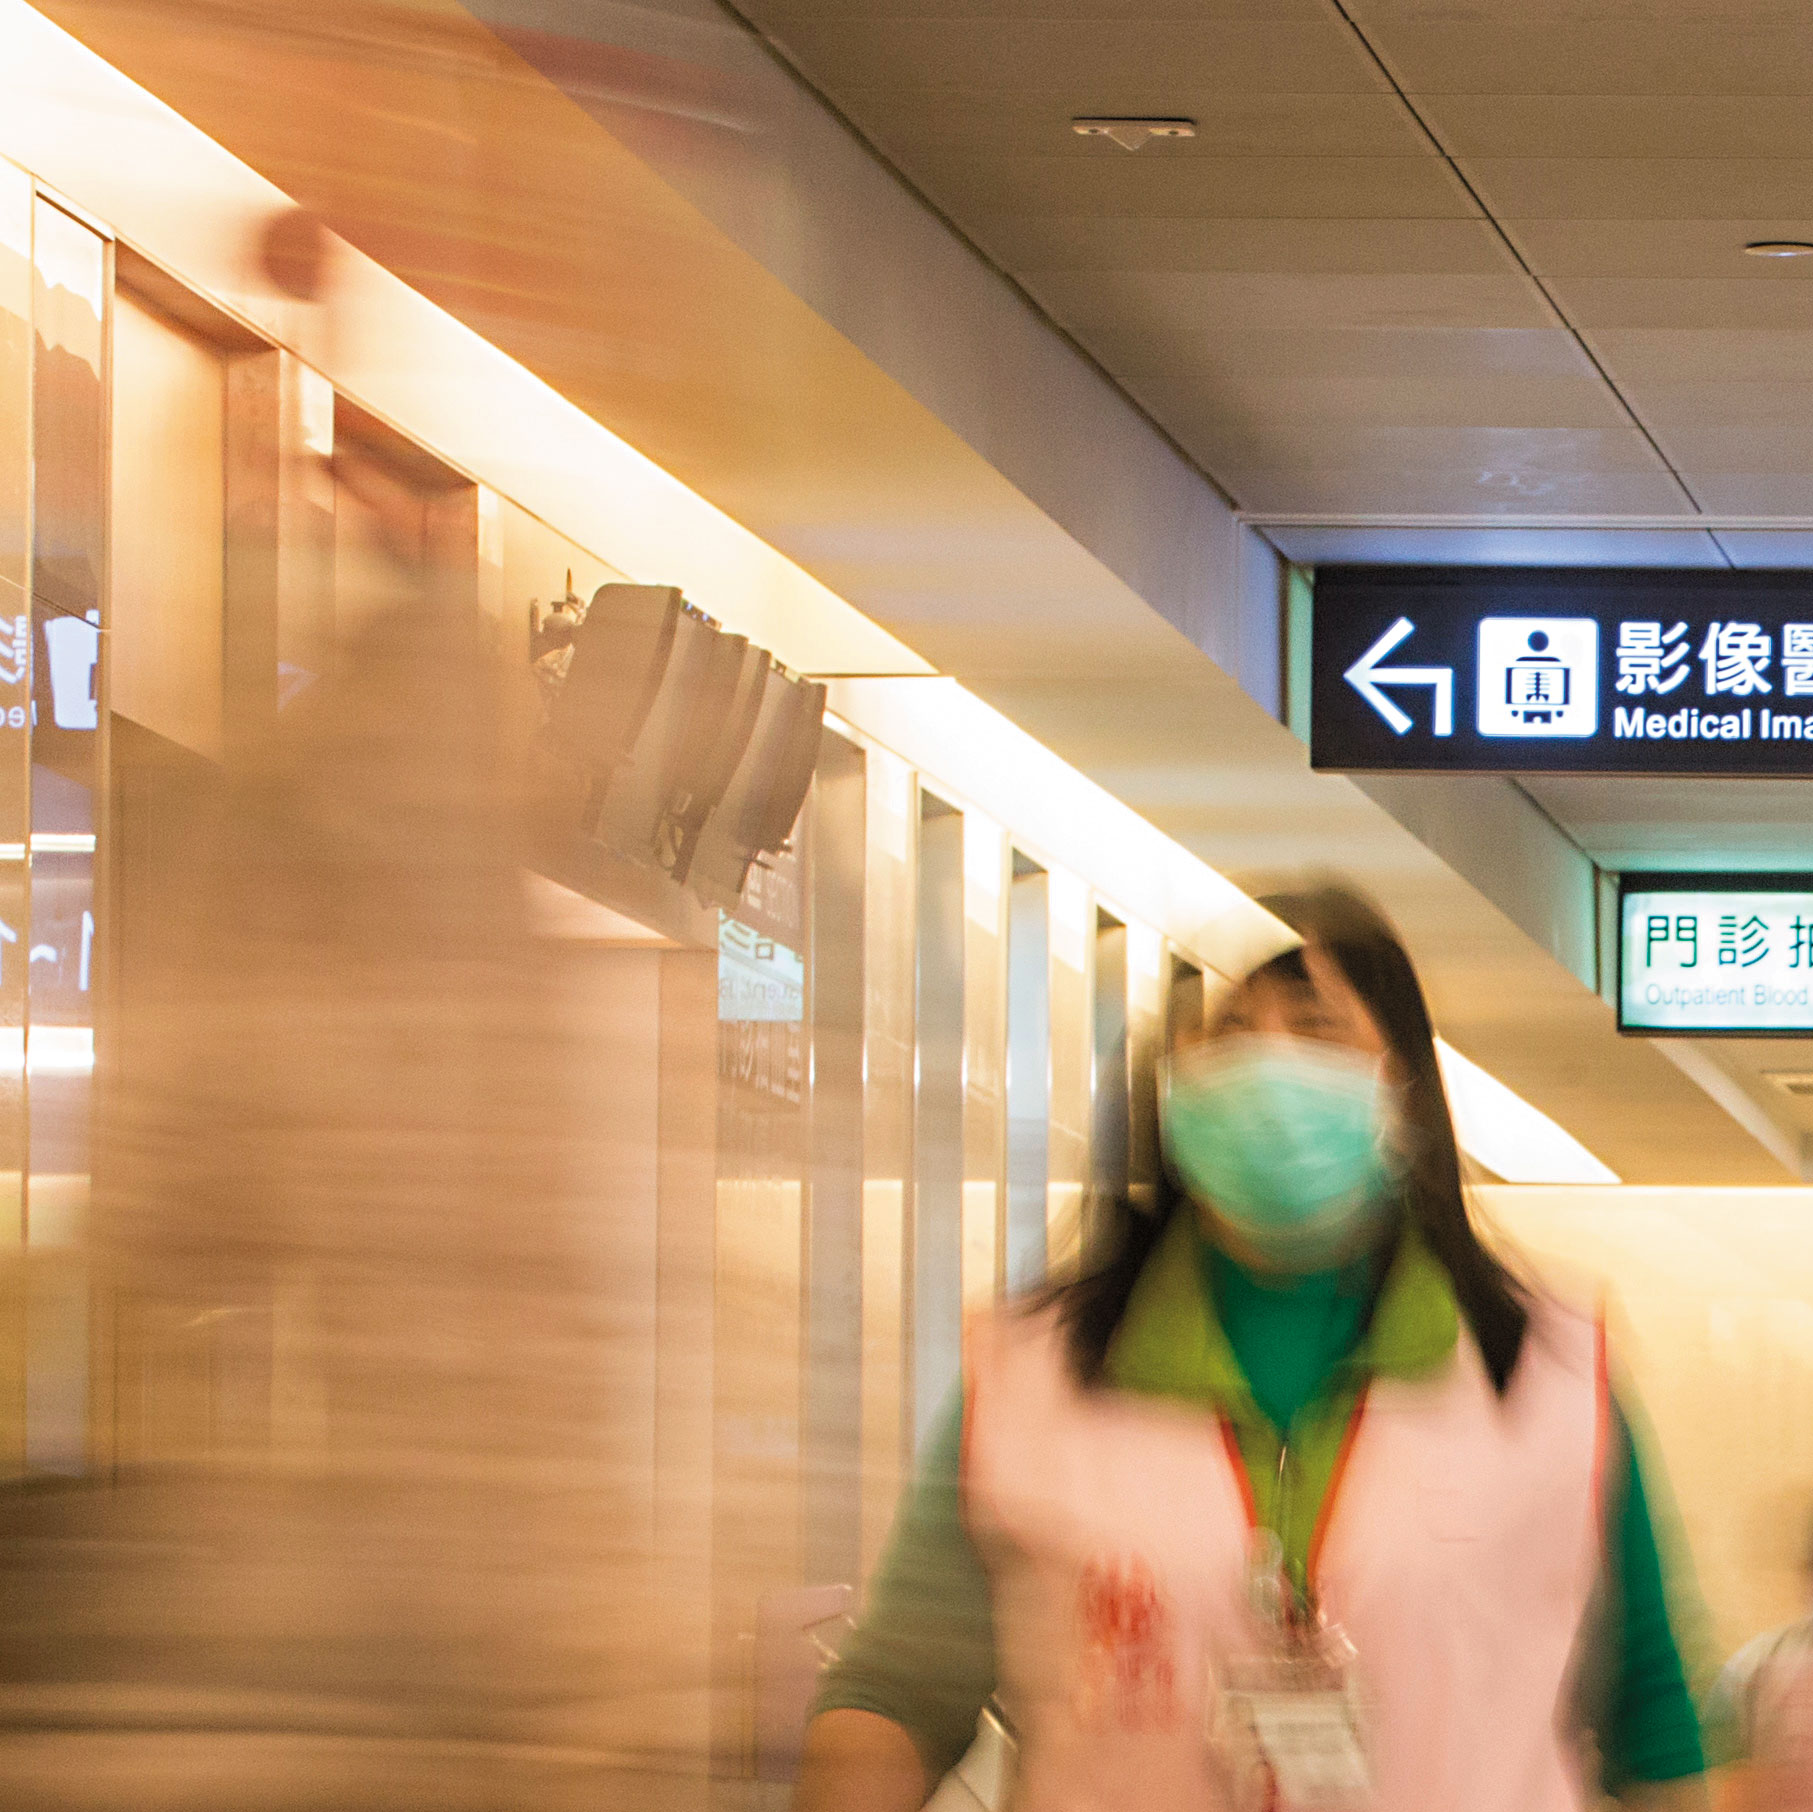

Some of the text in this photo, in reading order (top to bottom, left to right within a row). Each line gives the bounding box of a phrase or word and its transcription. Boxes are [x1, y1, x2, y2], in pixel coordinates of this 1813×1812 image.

[1614, 706, 1751, 739] Medical
[1646, 983, 1746, 1008] Outpatient
[1754, 983, 1808, 1006] Blood
